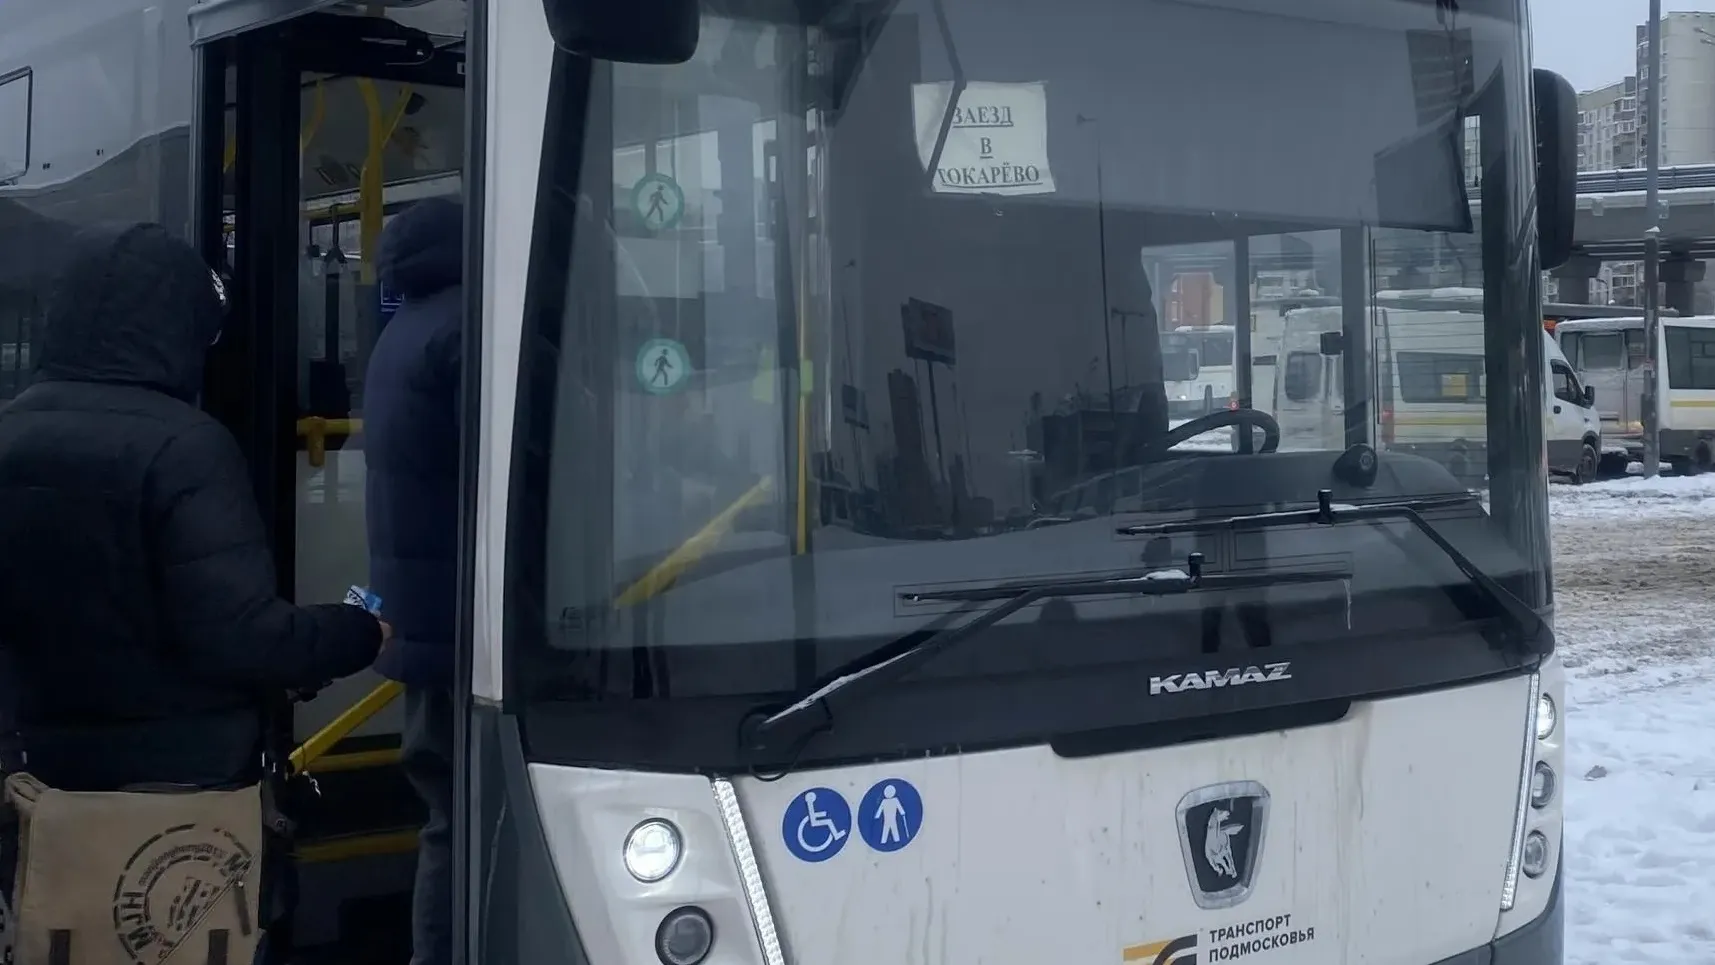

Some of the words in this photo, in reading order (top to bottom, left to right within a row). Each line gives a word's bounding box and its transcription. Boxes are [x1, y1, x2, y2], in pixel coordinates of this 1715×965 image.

[953, 106, 1013, 125] ЗАЕЗД
[980, 137, 992, 154] В
[1150, 662, 1292, 695] KAMAZ
[1209, 913, 1291, 943] ТРАНСПОРТ
[1209, 927, 1315, 963] ПОДМОСКОВЬЯ
